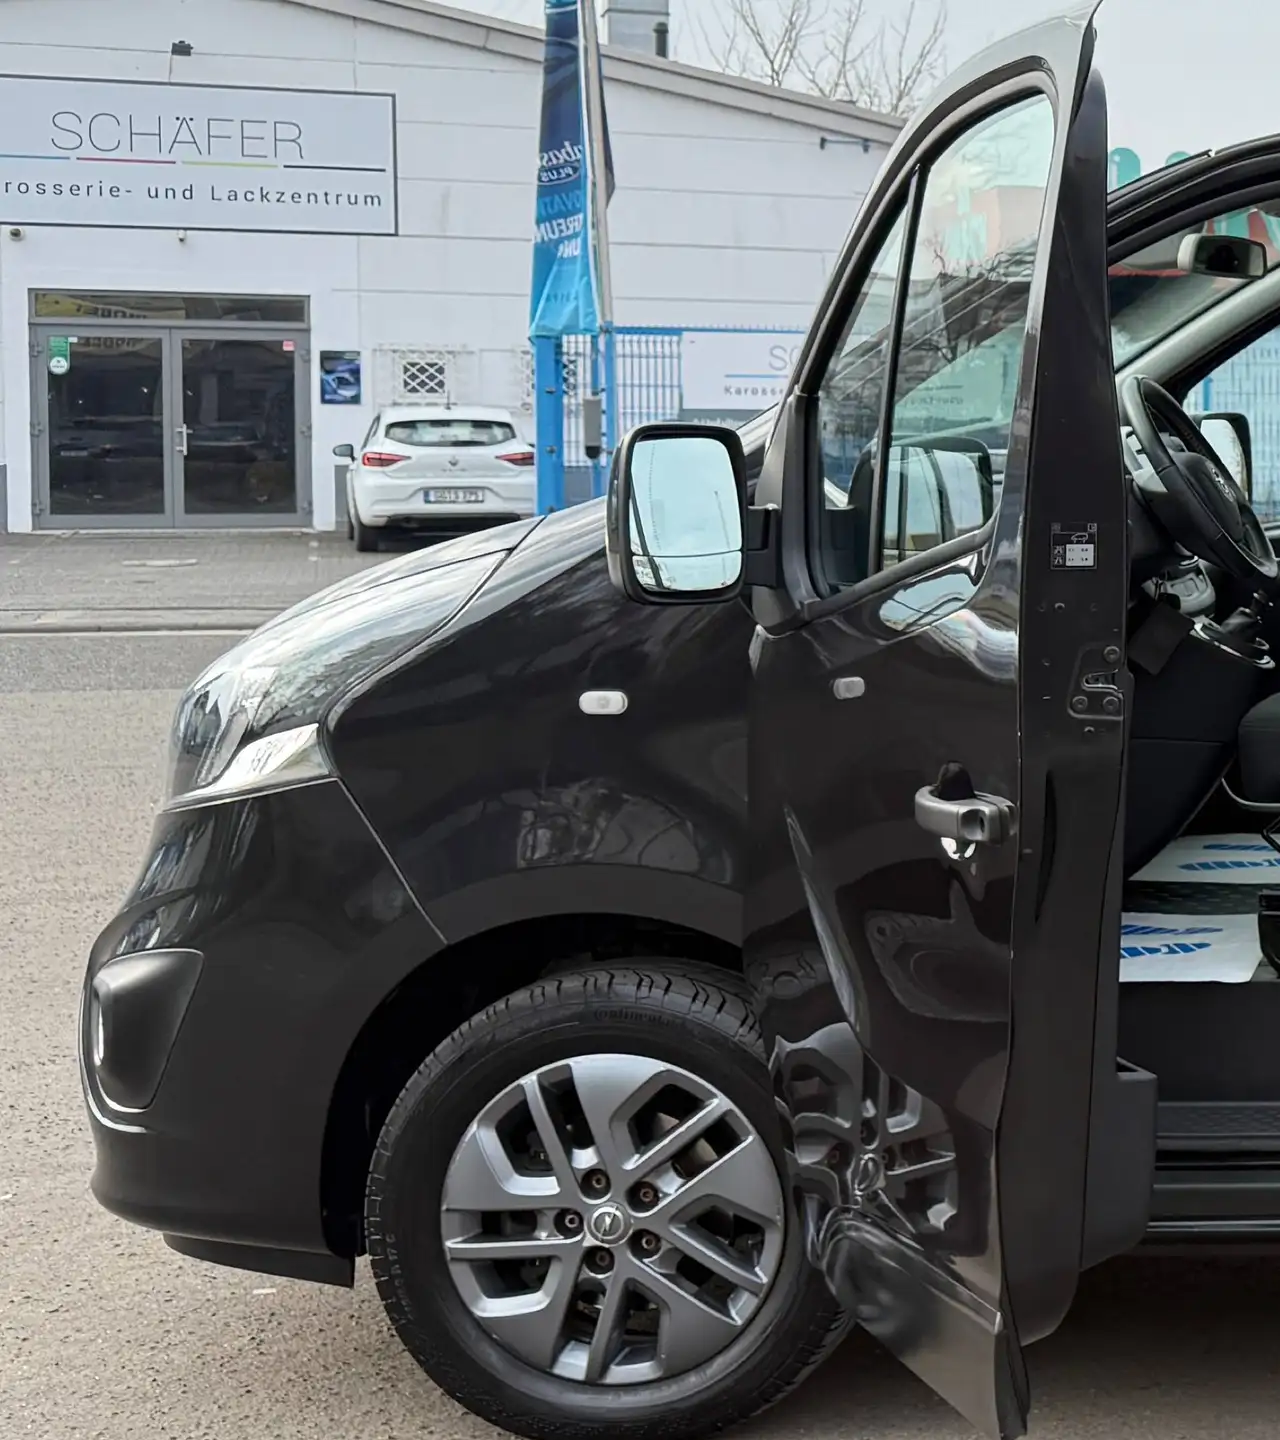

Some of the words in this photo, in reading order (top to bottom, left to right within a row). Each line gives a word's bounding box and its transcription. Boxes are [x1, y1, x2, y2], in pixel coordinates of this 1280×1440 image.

[51, 111, 304, 159] SCHÄFER
[147, 184, 194, 201] und
[211, 185, 382, 208] Lackzentrum
